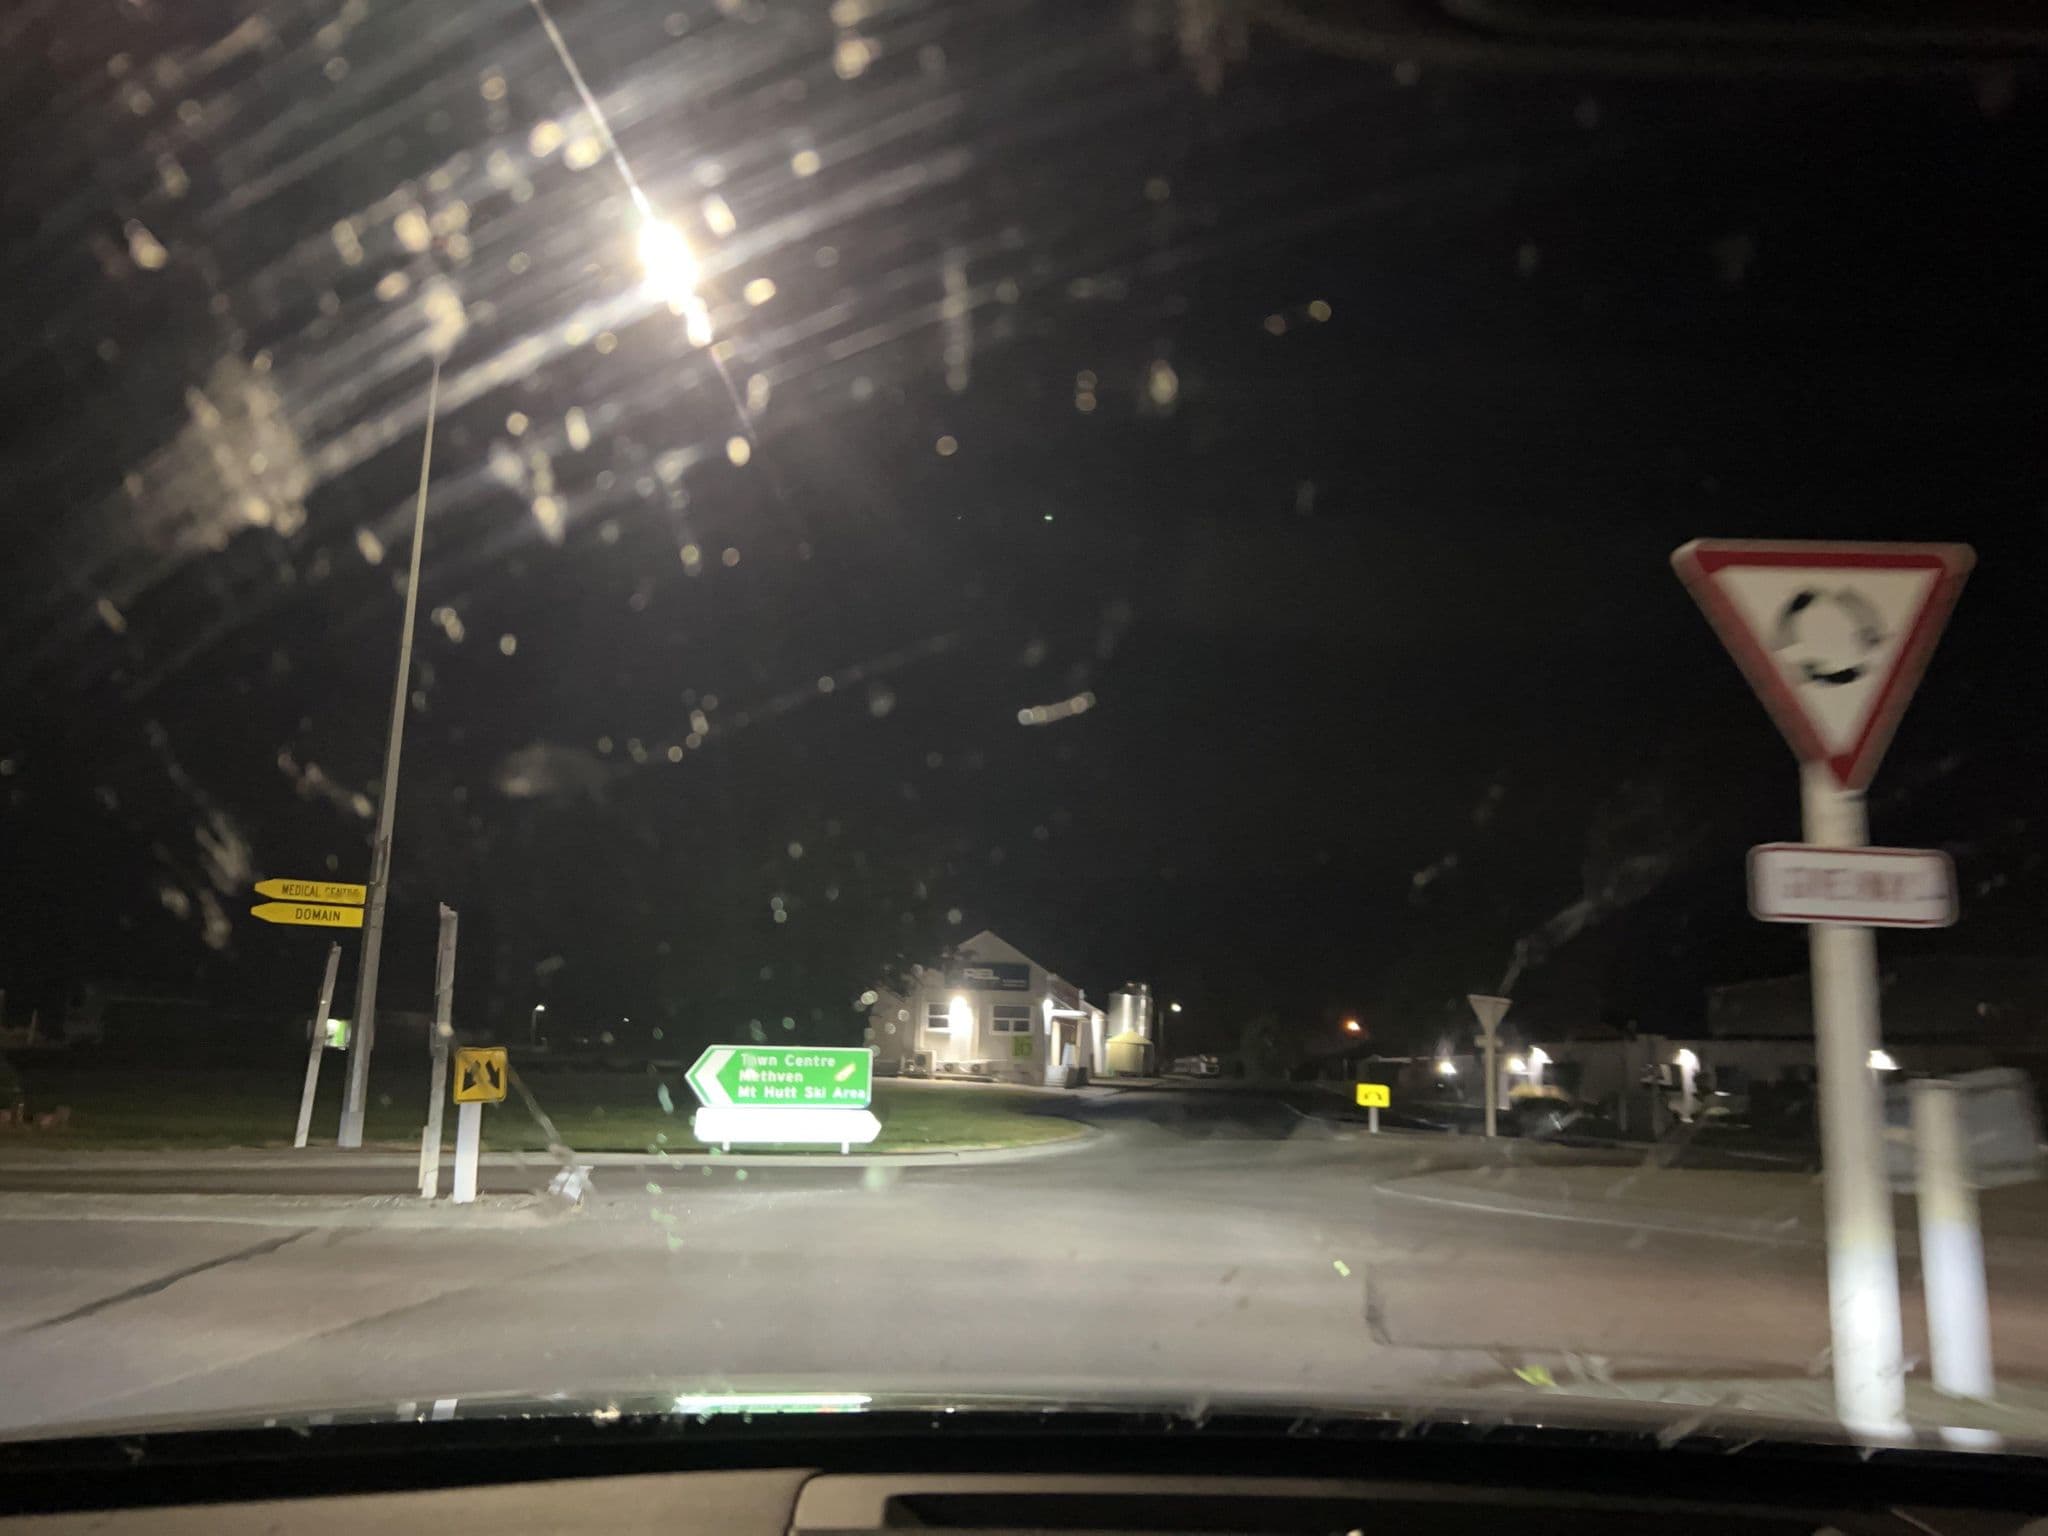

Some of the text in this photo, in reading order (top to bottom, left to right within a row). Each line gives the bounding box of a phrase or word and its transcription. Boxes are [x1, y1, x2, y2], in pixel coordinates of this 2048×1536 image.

[281, 884, 319, 897] MEDICAL
[295, 908, 340, 921] DOMAIN
[740, 1053, 836, 1067] Town Centre
[738, 1068, 803, 1082] Methven
[737, 1085, 866, 1099] Mt Hutt Ski Area
